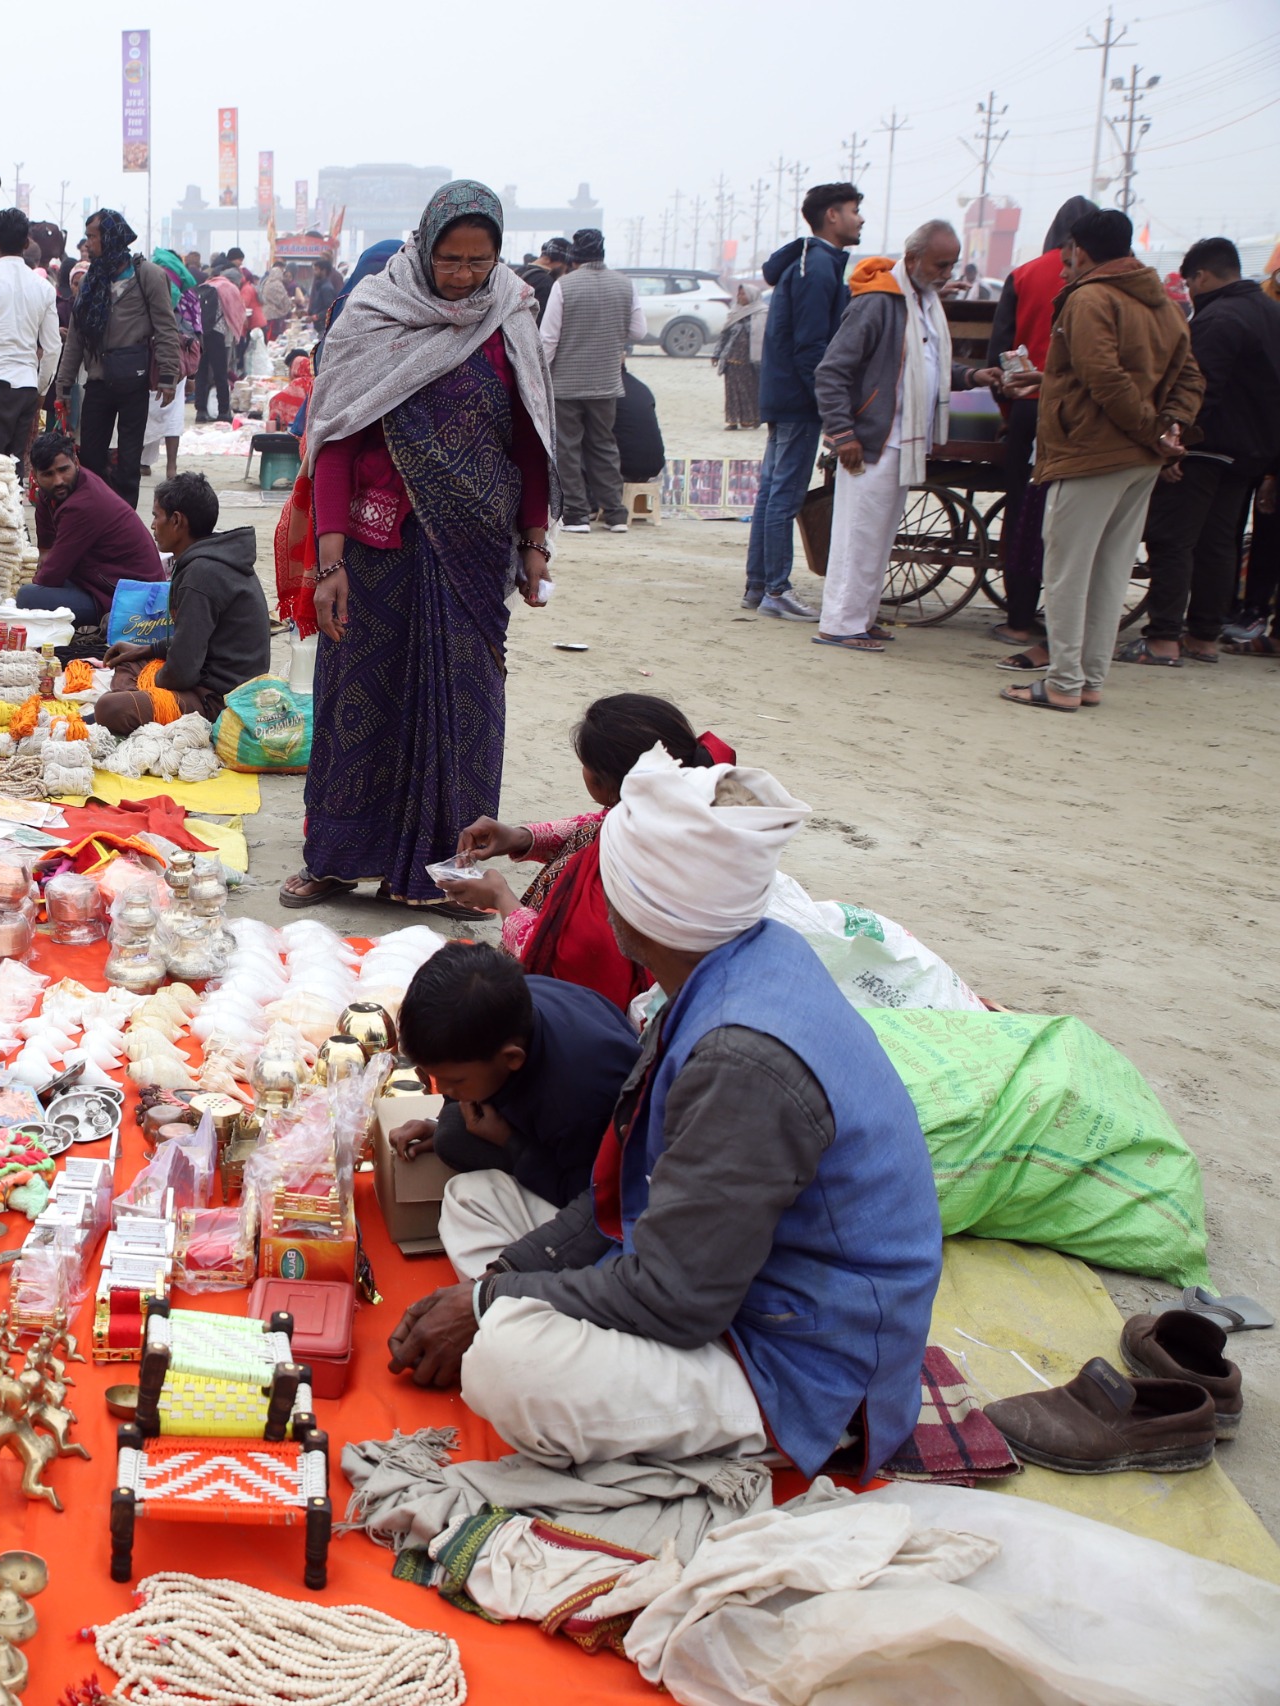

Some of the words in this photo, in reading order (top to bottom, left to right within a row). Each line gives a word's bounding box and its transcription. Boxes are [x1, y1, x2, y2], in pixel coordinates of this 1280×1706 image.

[128, 89, 141, 97] You
[126, 98, 136, 107] are
[124, 107, 146, 117] Plastic
[128, 118, 142, 127] Free
[127, 128, 143, 136] Zone
